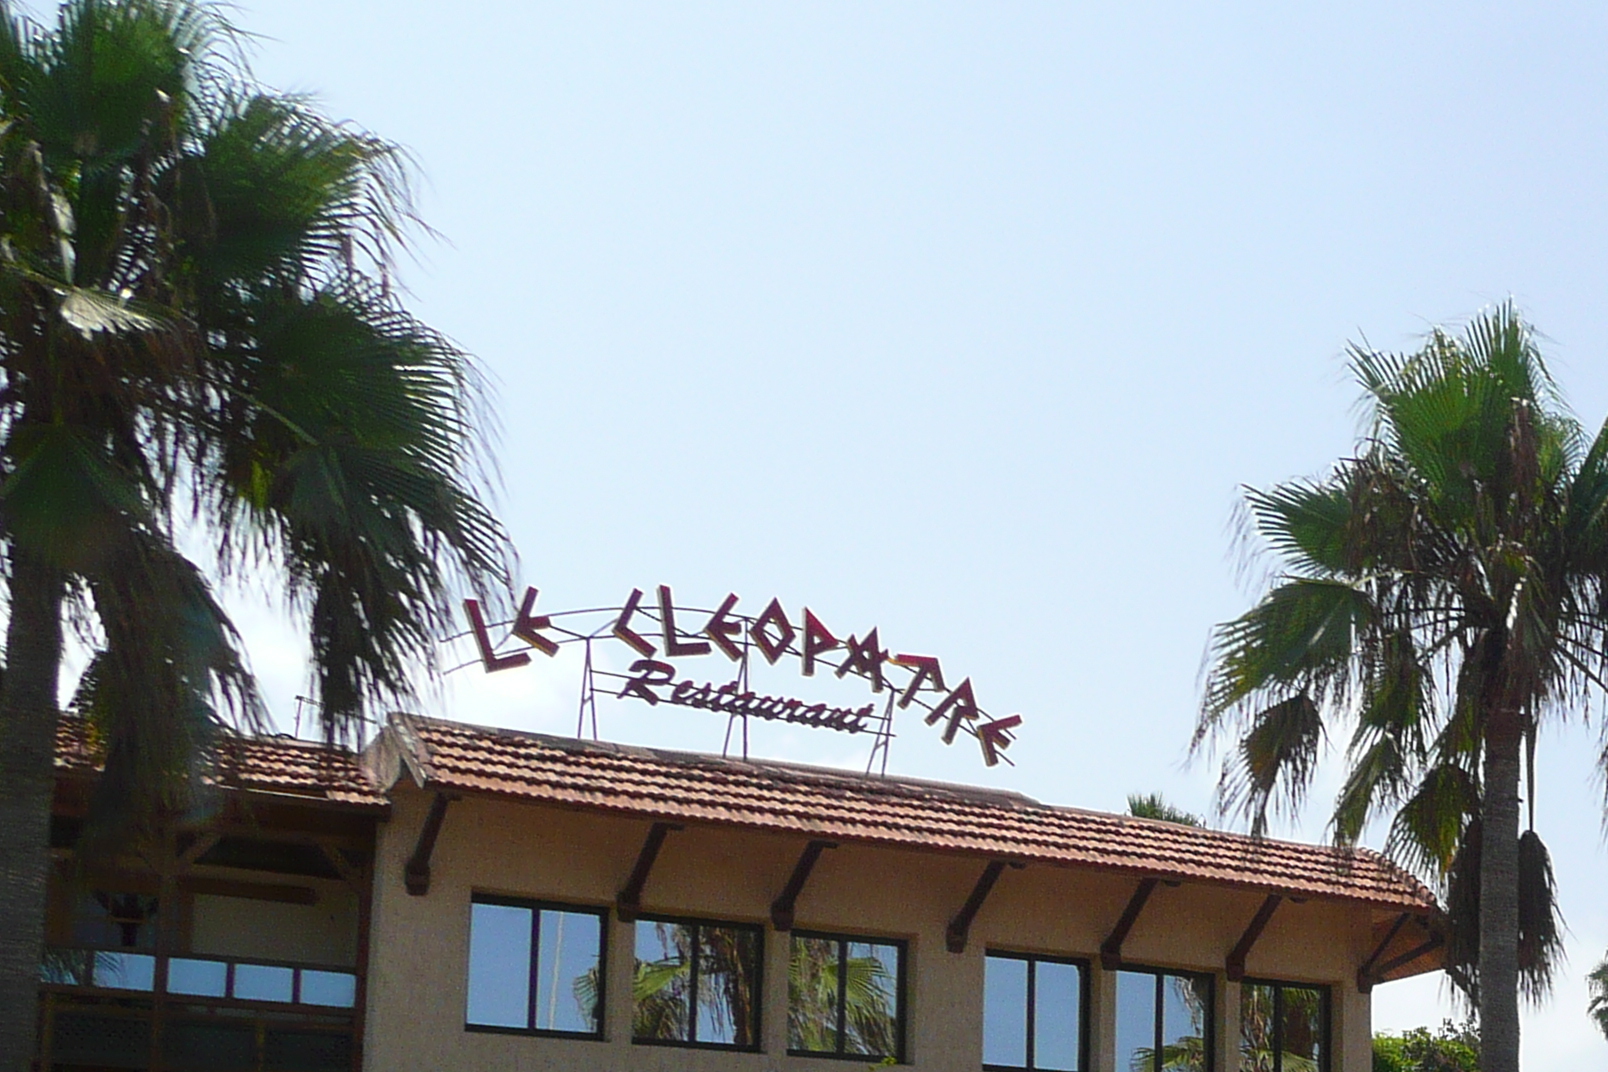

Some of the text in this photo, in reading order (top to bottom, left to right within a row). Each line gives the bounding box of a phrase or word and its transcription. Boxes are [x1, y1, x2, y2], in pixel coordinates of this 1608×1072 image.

[464, 584, 1022, 767] LE CLEOPATRE
[617, 659, 874, 734] Restaurant
